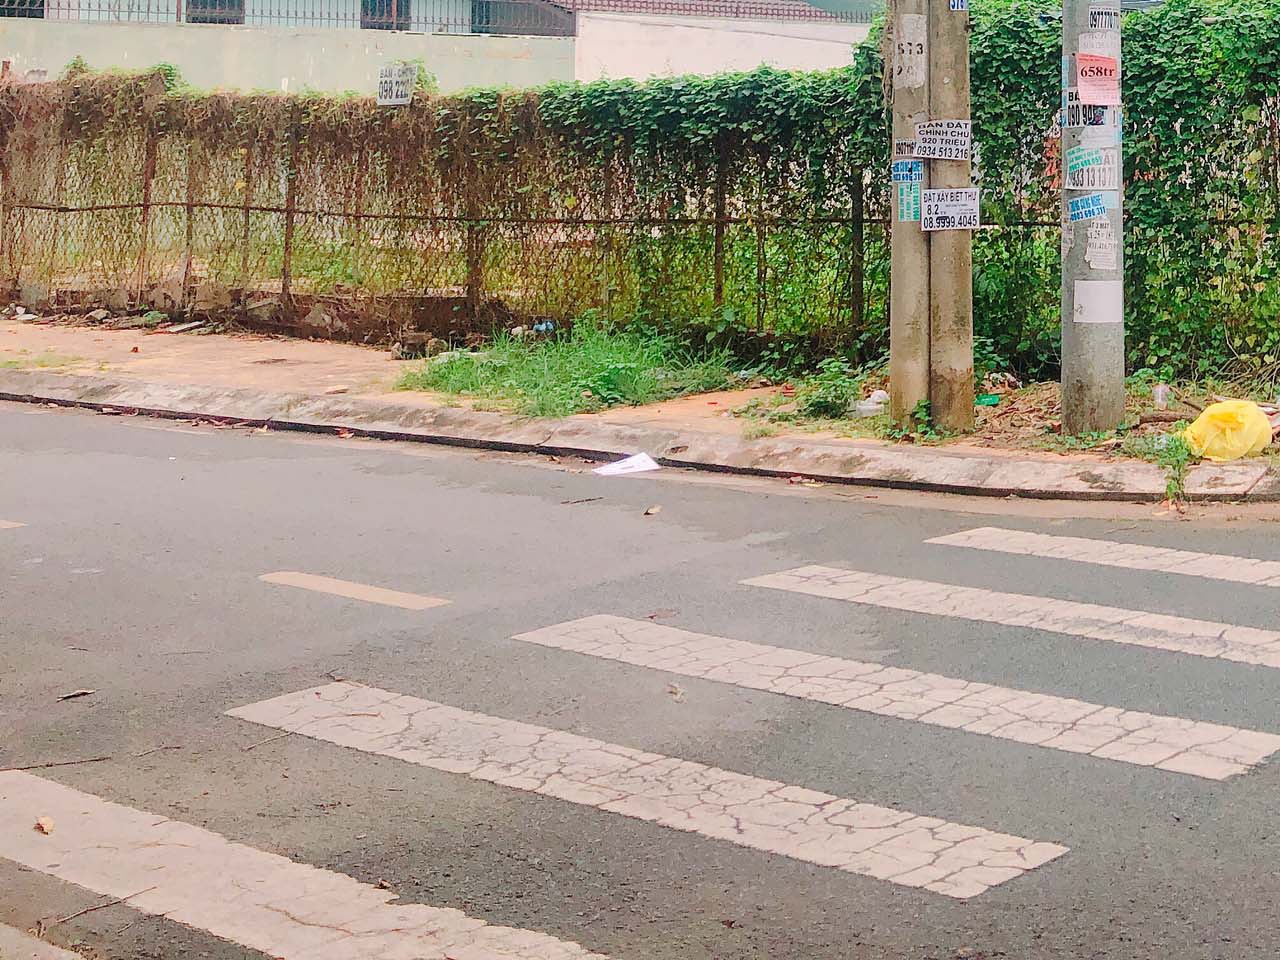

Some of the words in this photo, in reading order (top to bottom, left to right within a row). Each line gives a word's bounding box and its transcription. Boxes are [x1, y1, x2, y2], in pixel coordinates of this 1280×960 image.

[1080, 66, 1115, 78] 658tr
[921, 137, 938, 145] 920
[916, 145, 937, 157] 0934
[938, 146, 953, 159] 513
[954, 147, 969, 159] 216
[926, 204, 939, 215] 8.2
[923, 215, 978, 229] 08.9999.4045
